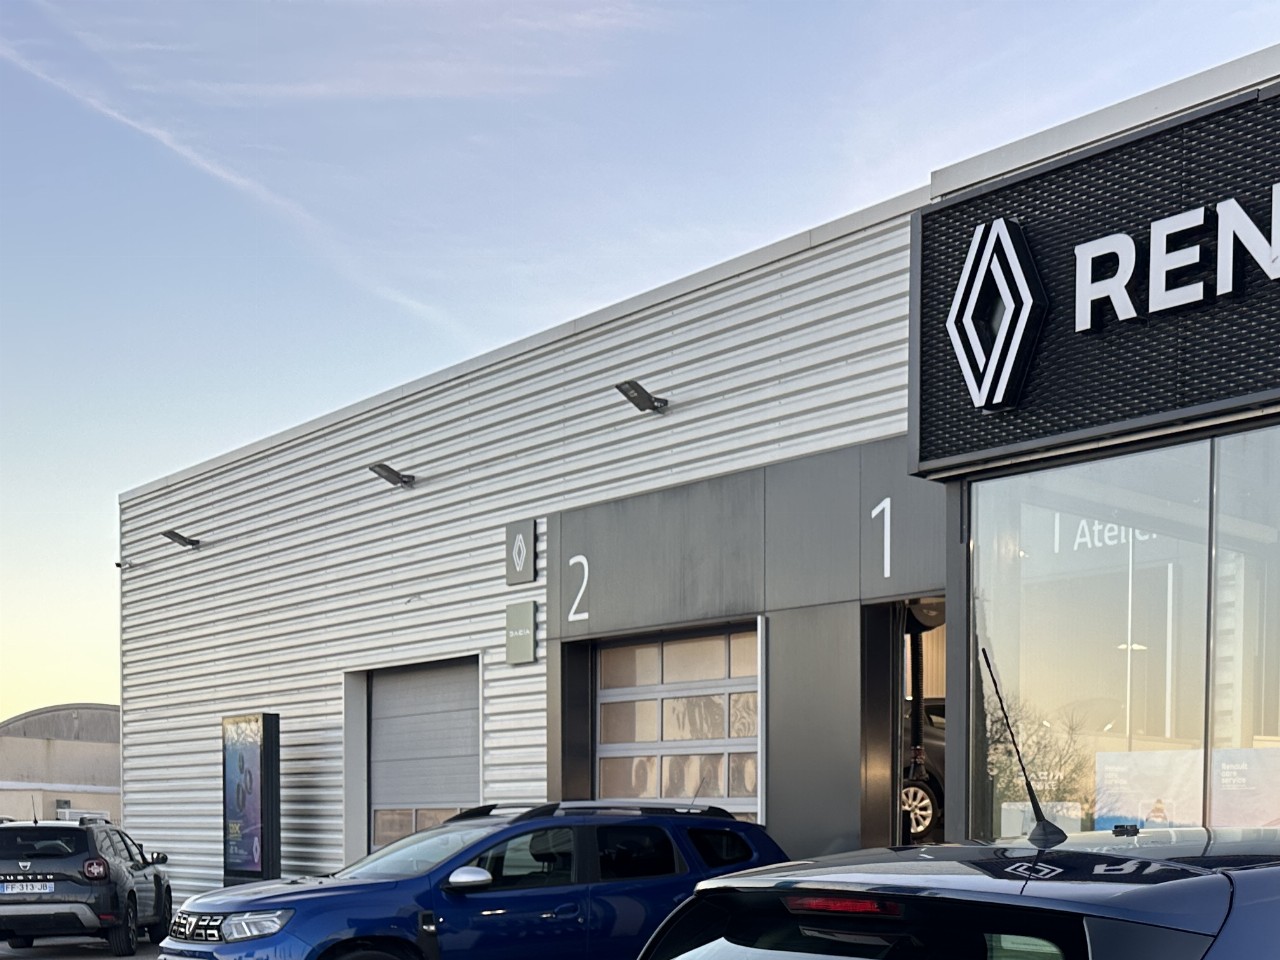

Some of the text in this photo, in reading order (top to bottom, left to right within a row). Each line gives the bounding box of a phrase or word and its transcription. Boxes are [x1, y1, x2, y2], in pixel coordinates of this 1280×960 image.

[871, 497, 890, 578] 1
[568, 555, 588, 621] 2
[1221, 761, 1248, 770] Renault
